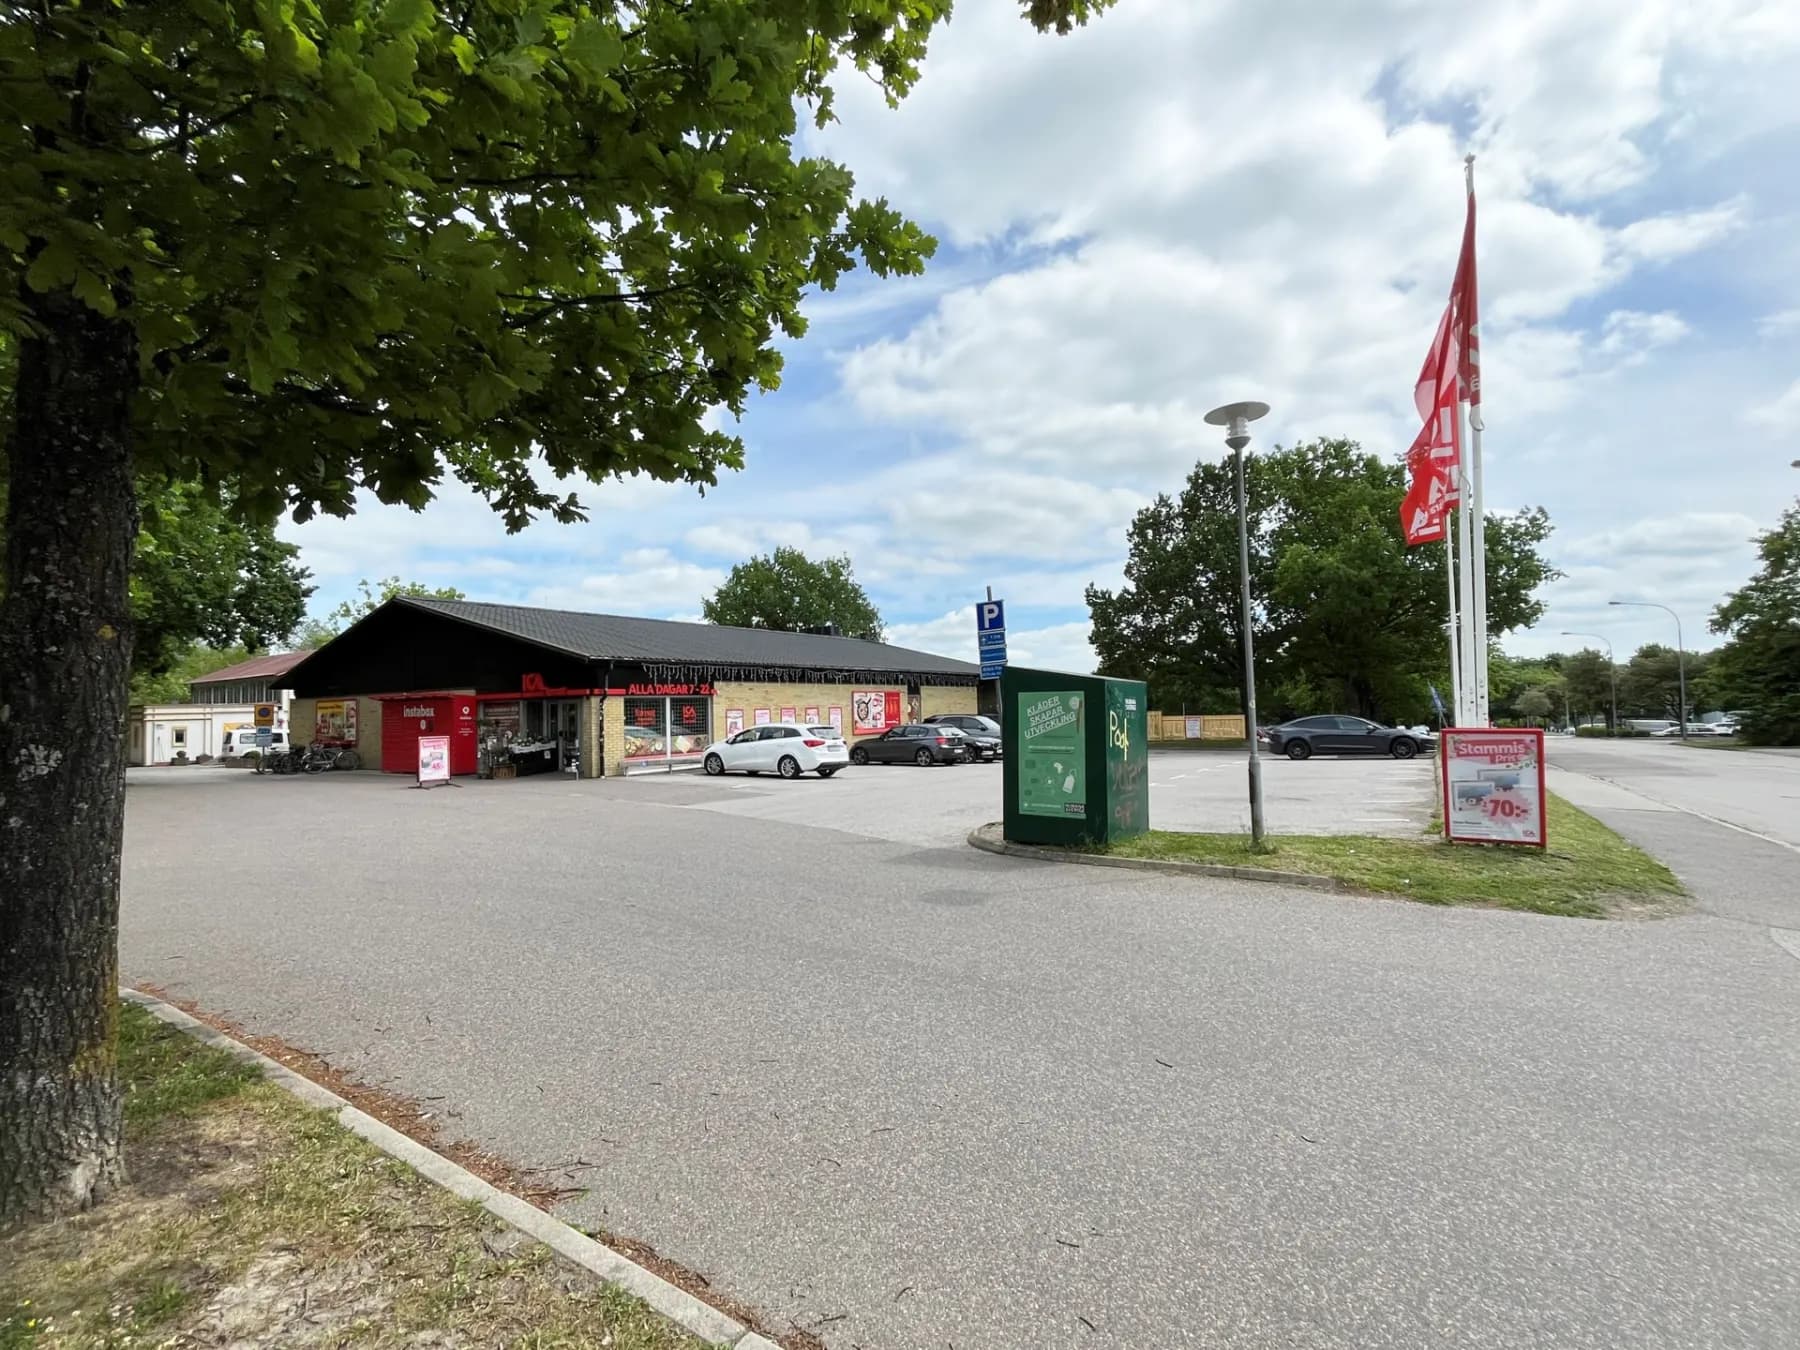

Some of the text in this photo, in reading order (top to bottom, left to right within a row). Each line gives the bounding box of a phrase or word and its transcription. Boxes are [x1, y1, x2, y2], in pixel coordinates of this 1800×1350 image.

[983, 604, 999, 629] P
[522, 673, 546, 692] ICA
[628, 684, 654, 695] ALLA
[655, 684, 689, 695] DAGAR
[689, 684, 695, 695] 7
[700, 684, 710, 695] 22
[403, 704, 435, 717] instabox
[683, 705, 696, 715] ICA
[1027, 696, 1060, 717] KLÄDER
[1030, 706, 1063, 726] SKAPAR
[1024, 711, 1077, 738] UTVECKLING
[1459, 742, 1525, 755] Stammis
[1489, 799, 1528, 818] 70:-
